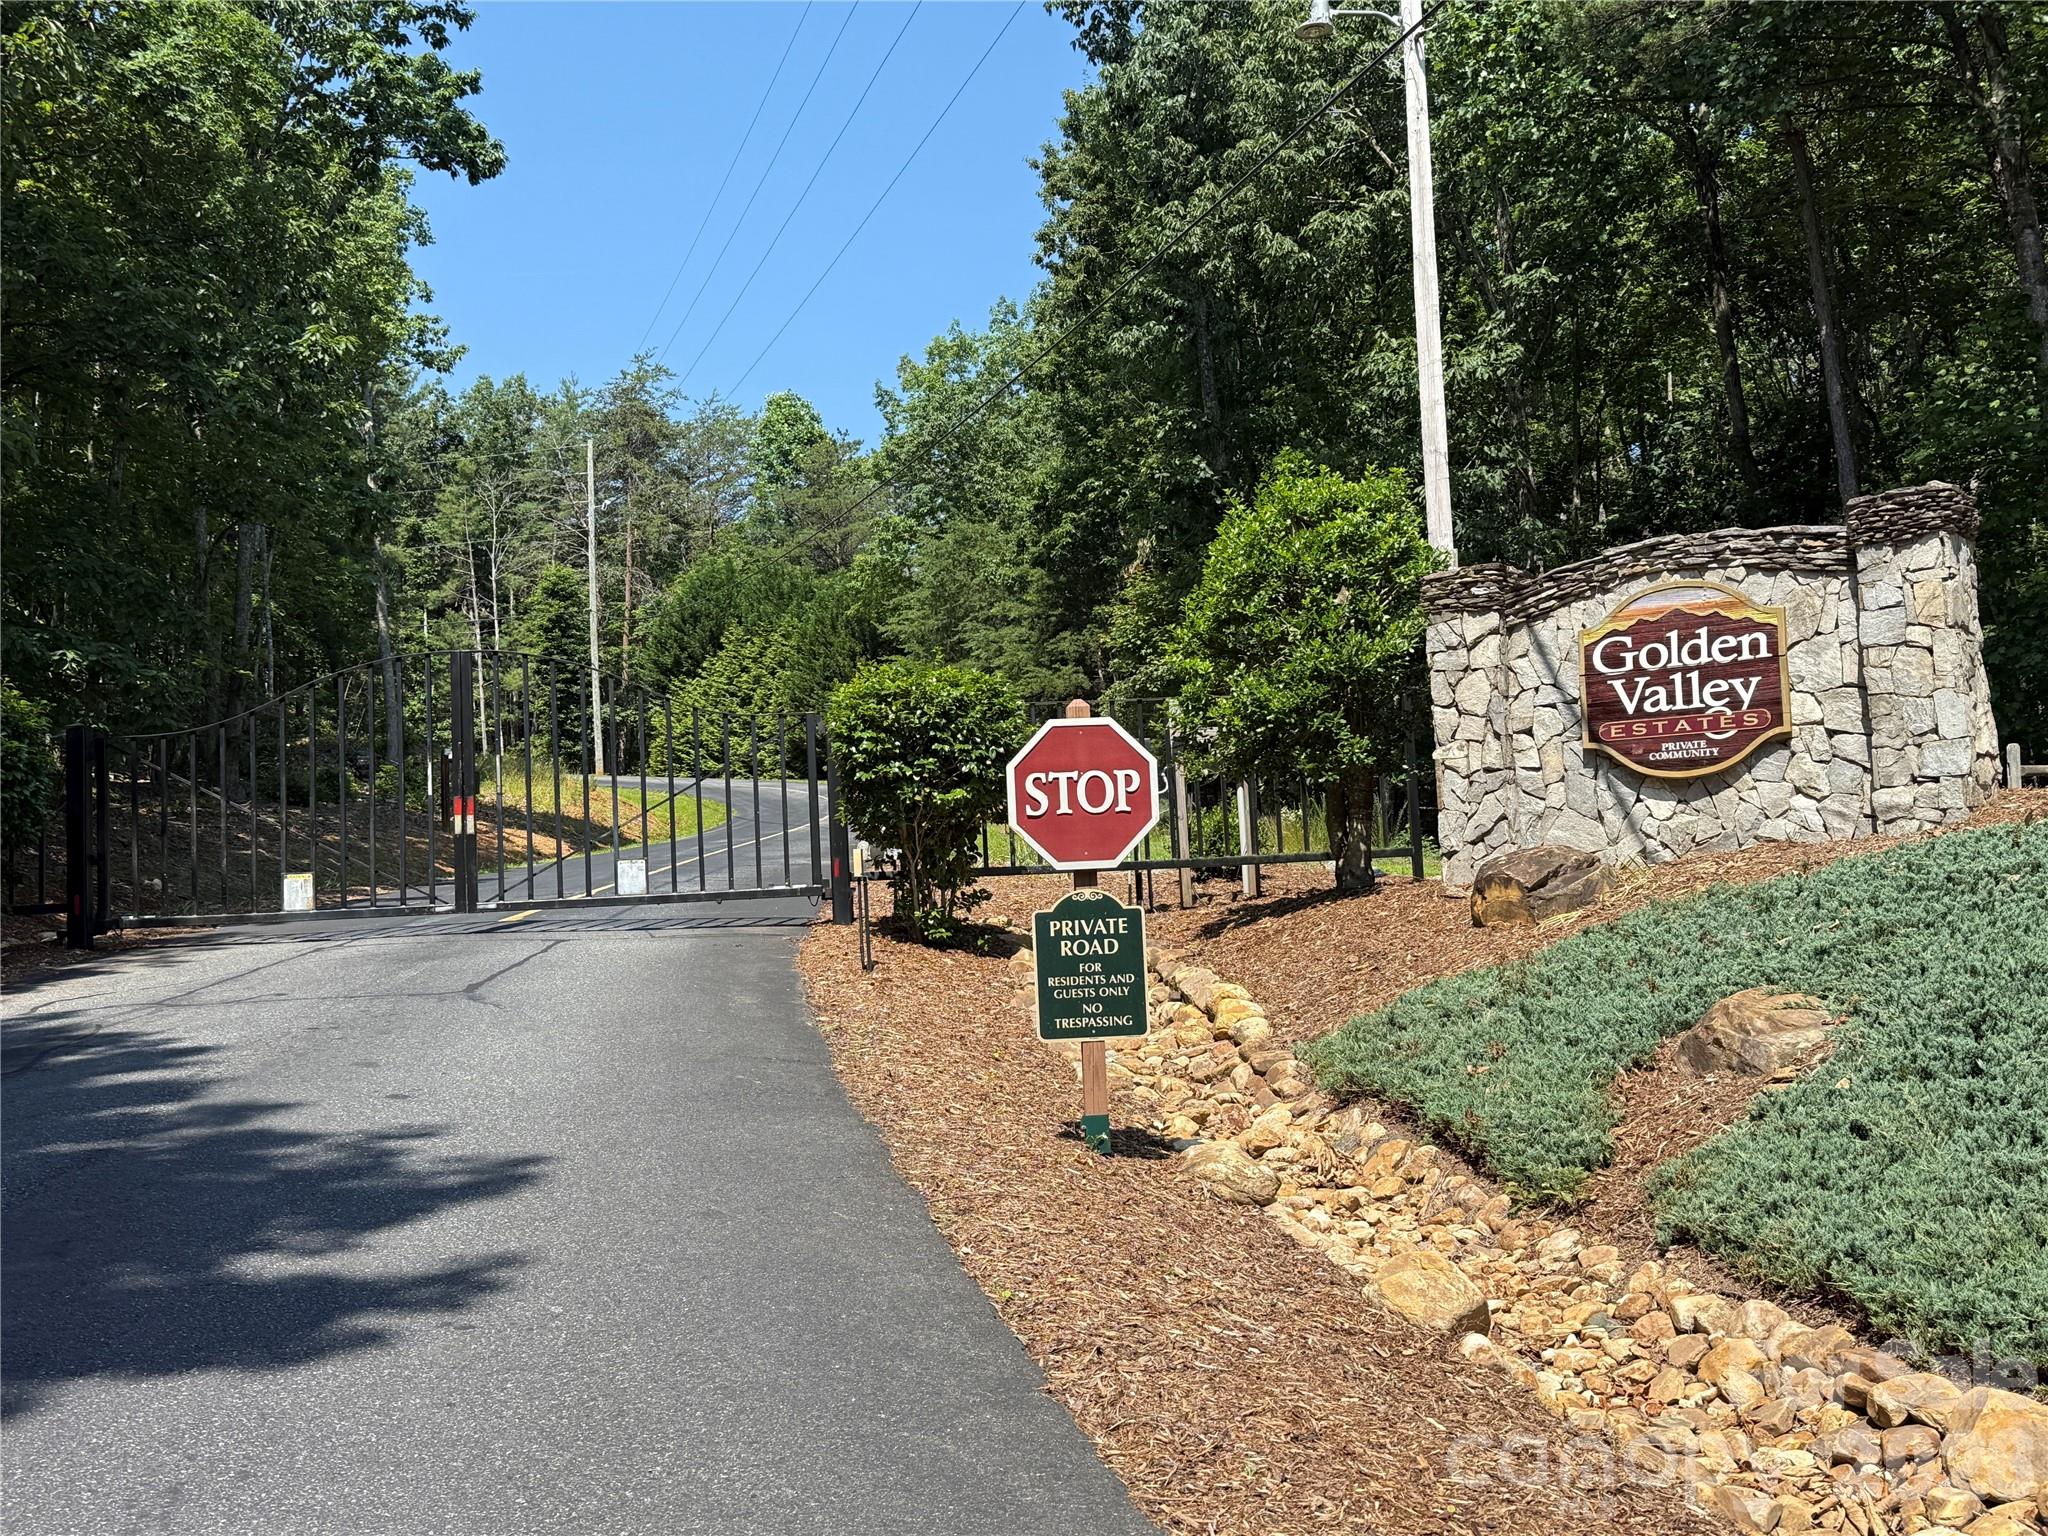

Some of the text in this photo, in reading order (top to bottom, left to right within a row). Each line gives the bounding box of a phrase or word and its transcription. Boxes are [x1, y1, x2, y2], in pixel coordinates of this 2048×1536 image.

[1592, 626, 1772, 675] Golden
[1607, 671, 1762, 718] Valley
[1610, 713, 1759, 738] ESTATES
[1661, 739, 1708, 752] PRIVATE
[1649, 747, 1720, 761] COMMUNITY
[1024, 768, 1141, 818] STOP
[1049, 917, 1129, 937] PRIVATE
[1060, 937, 1119, 957] ROAD
[1079, 962, 1102, 973] FOR
[1047, 973, 1135, 987] RESIDENTS AND
[1053, 986, 1130, 999] GUESTS ONLY
[1082, 1002, 1103, 1014] NO
[1054, 1014, 1133, 1029] TRESPASSING
